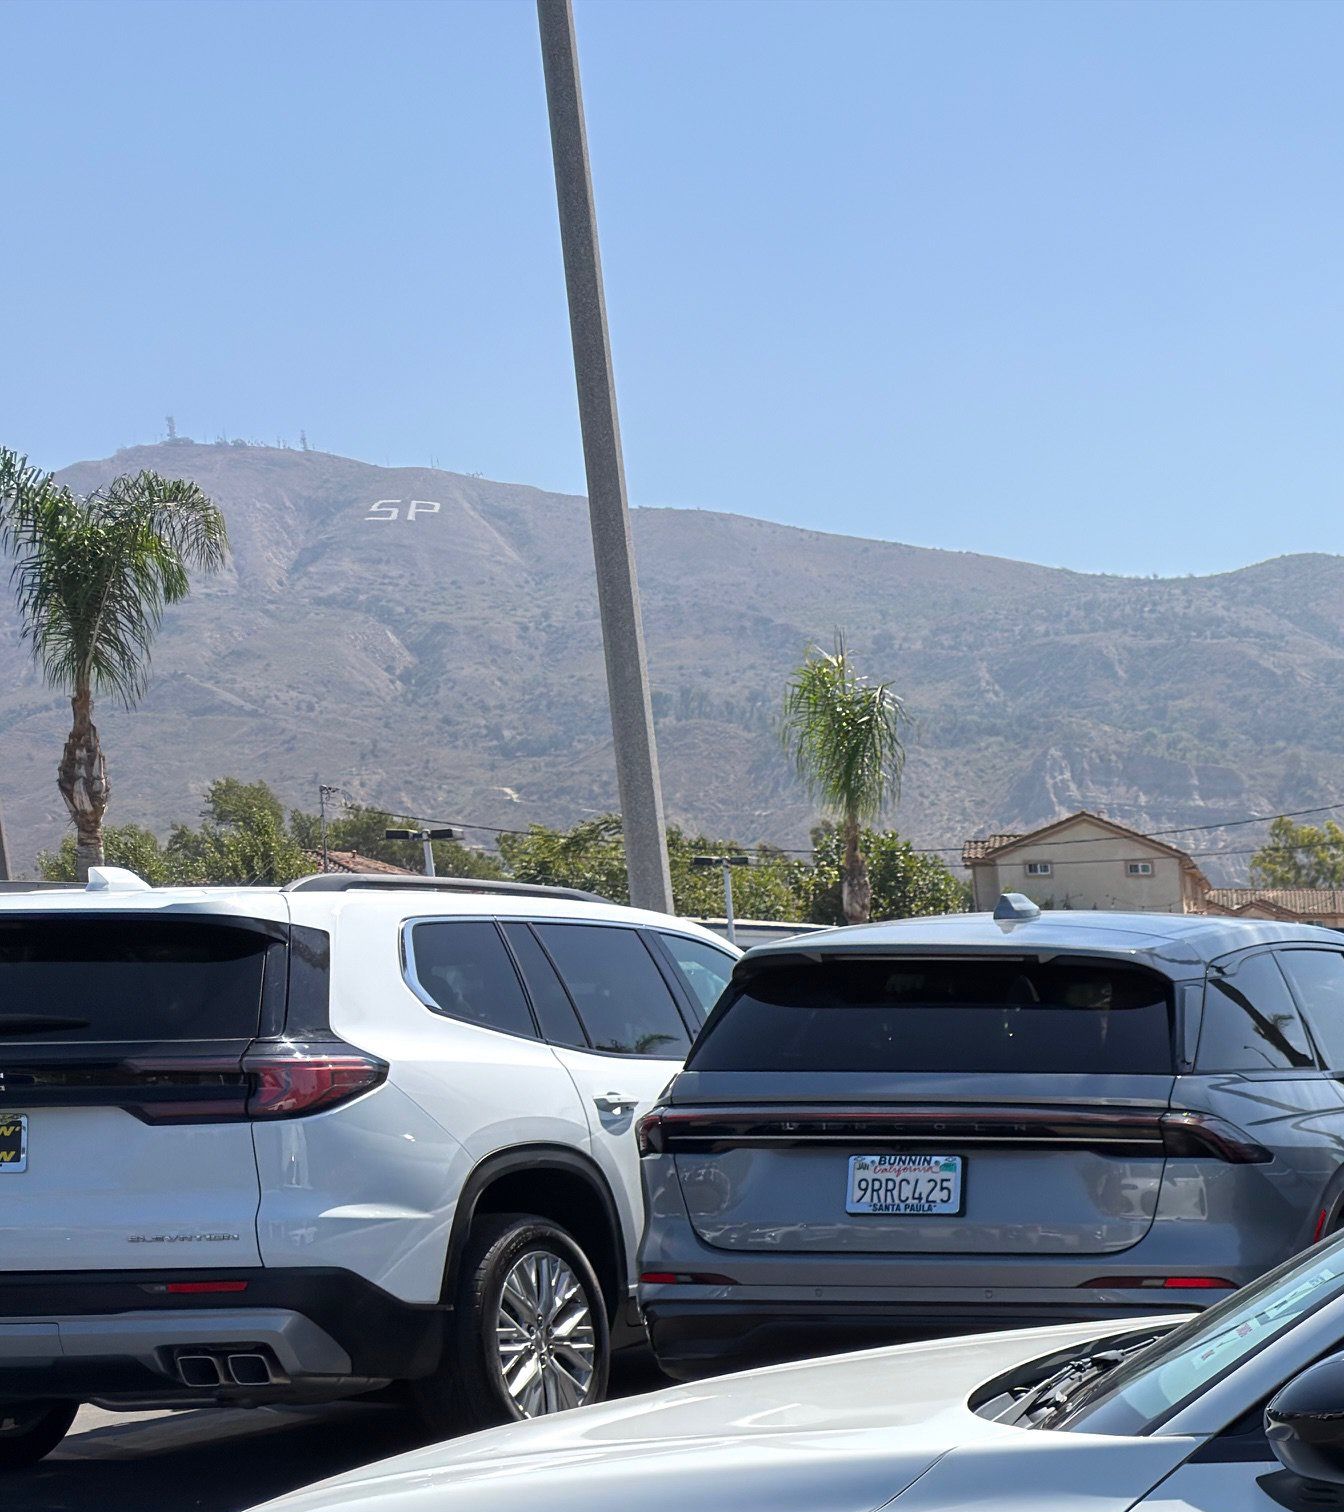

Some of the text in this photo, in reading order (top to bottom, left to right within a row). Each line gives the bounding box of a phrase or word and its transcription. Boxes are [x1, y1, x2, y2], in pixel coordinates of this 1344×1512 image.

[365, 499, 440, 521] SP
[878, 1156, 932, 1166] BUNNIN
[873, 1164, 939, 1177] California
[856, 1178, 951, 1203] 9RRC425
